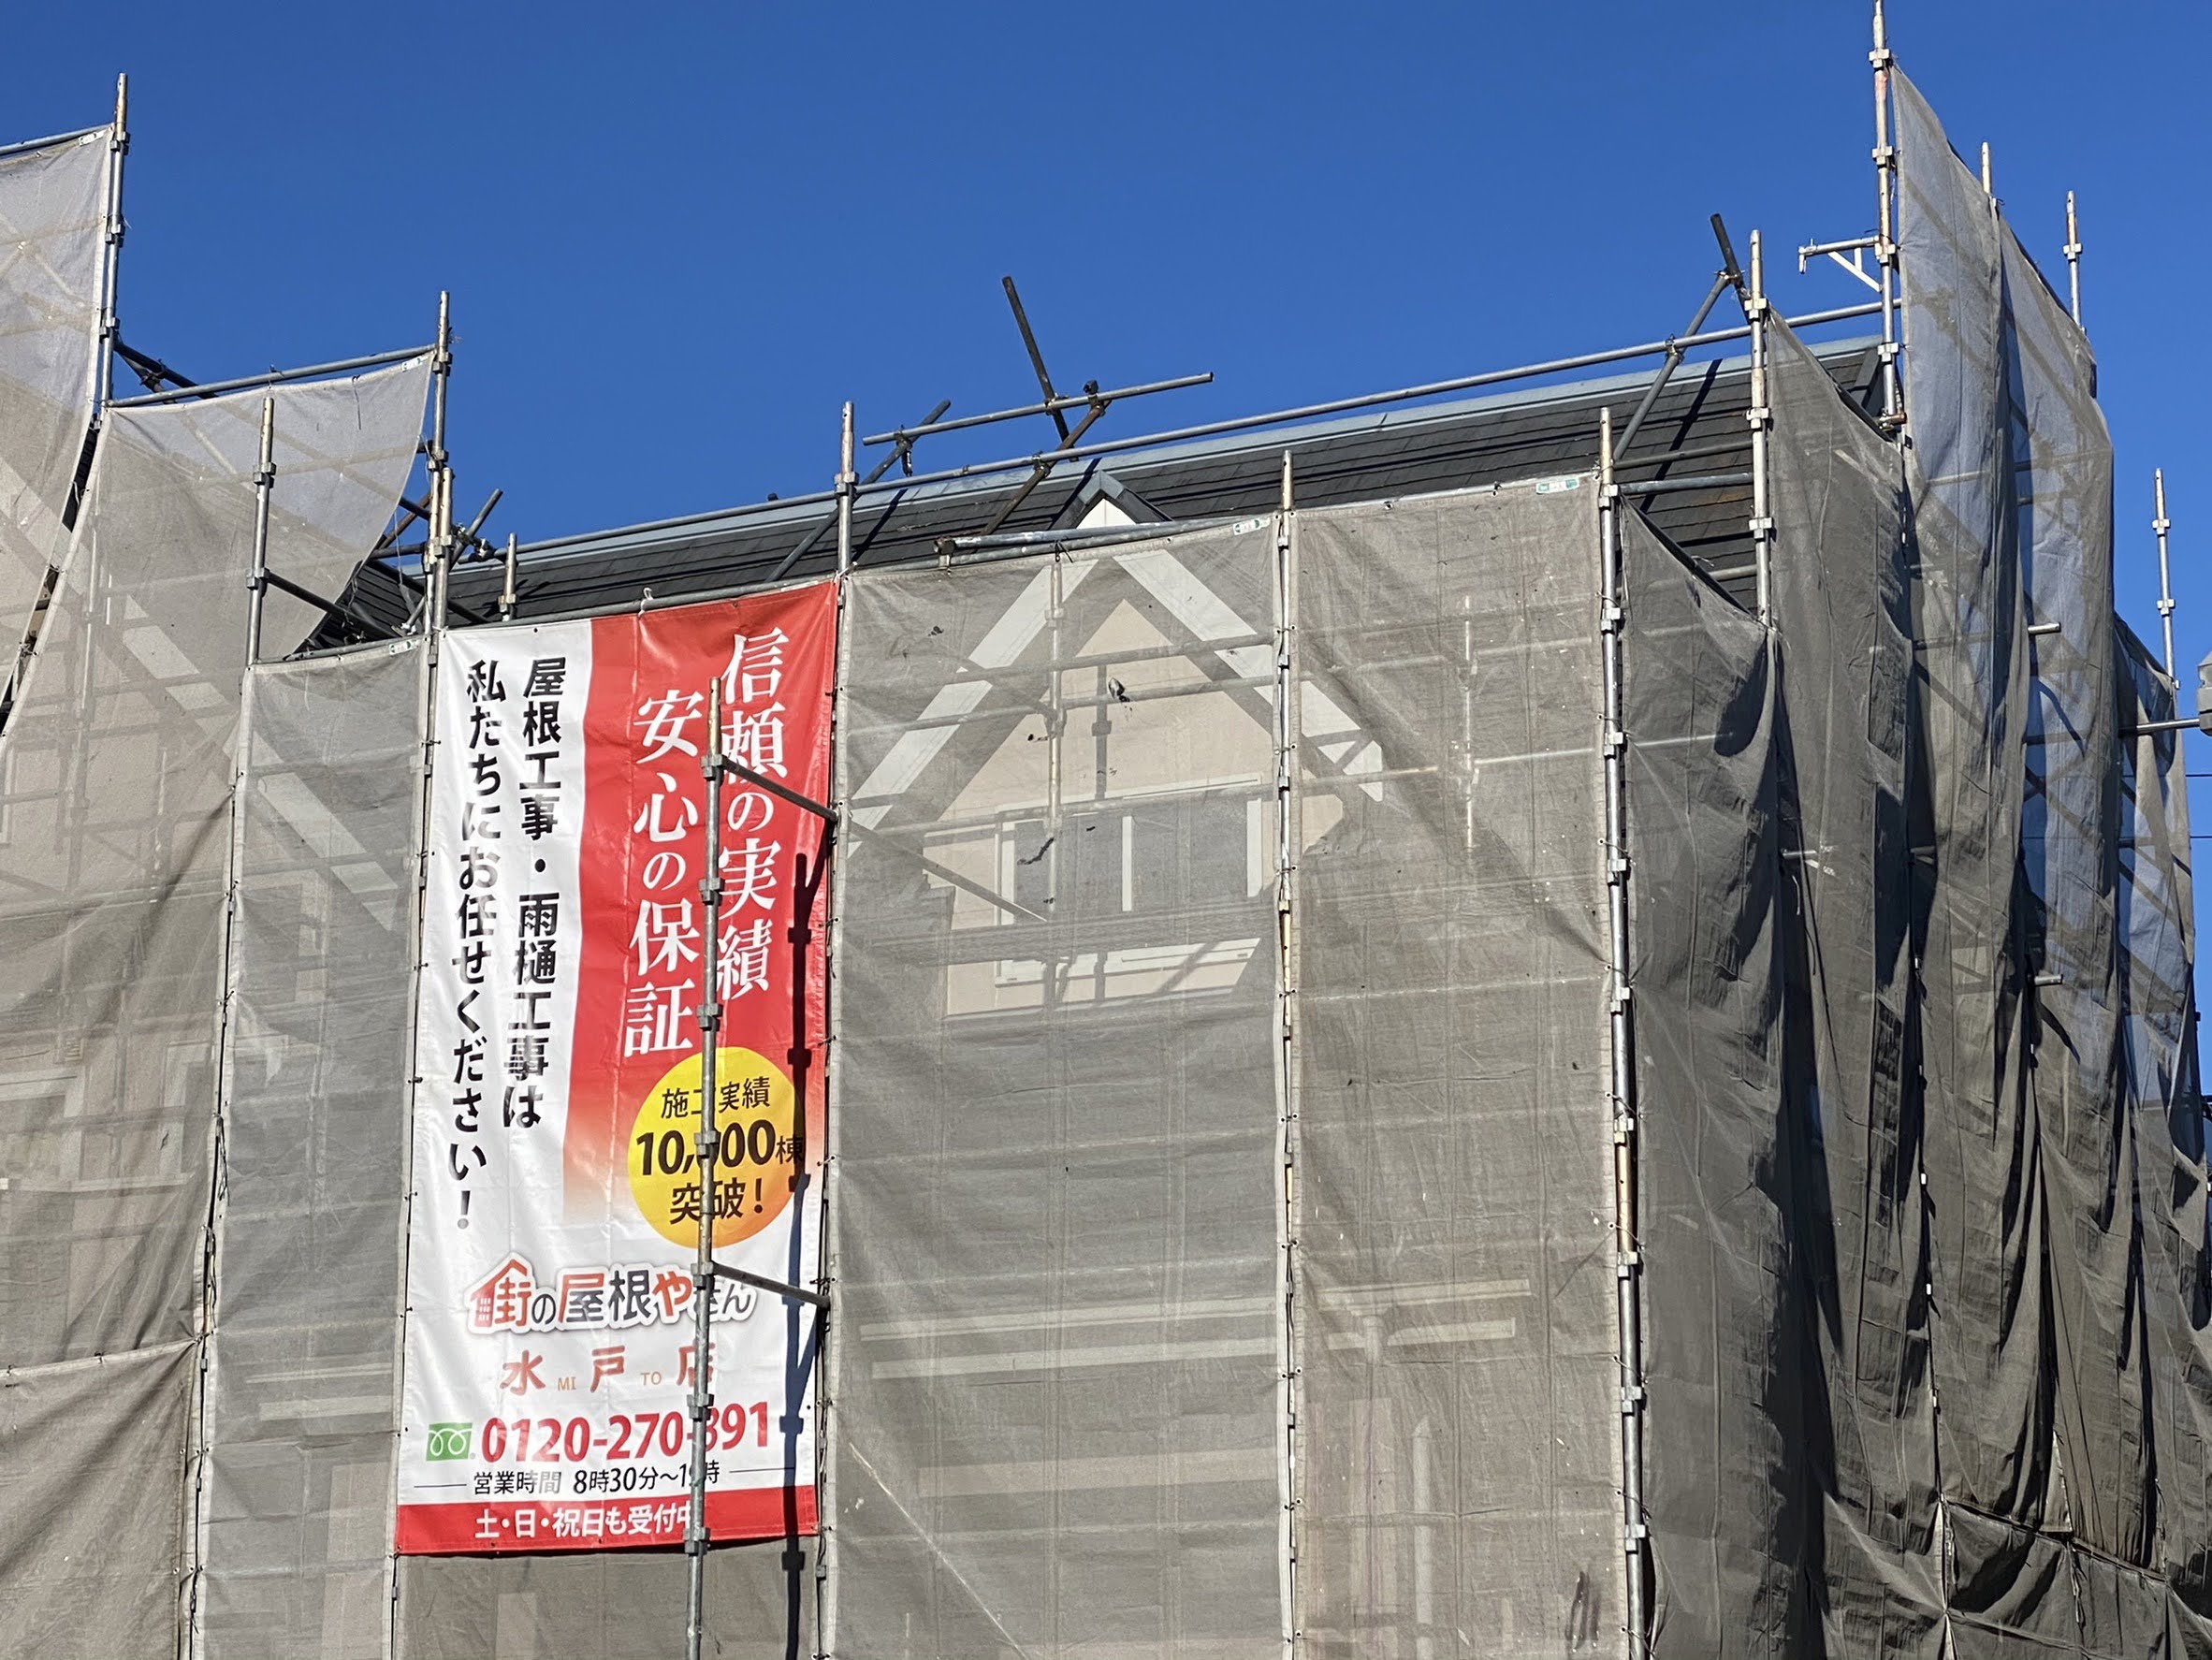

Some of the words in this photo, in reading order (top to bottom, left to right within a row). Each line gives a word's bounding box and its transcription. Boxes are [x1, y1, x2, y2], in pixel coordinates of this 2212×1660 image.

[447, 659, 507, 1230] 私たちにお任せください！
[502, 657, 567, 1129] 屋根工事・雨樋工事は
[623, 689, 705, 1058] 安心の保証
[715, 626, 790, 1001] 信頼の実績
